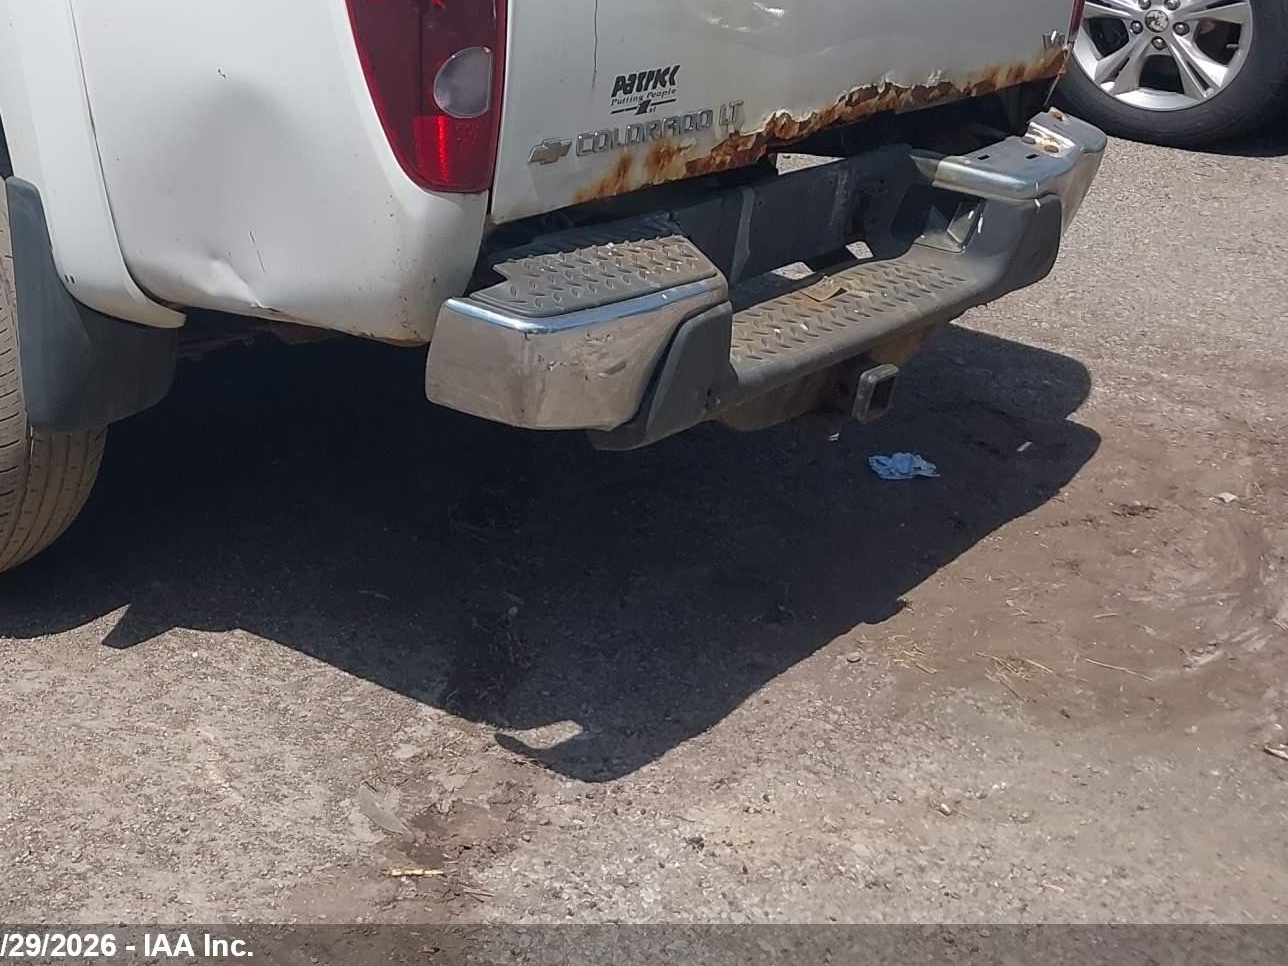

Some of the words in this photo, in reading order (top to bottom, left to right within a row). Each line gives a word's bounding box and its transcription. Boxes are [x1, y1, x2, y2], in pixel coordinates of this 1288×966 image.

[611, 94, 644, 107] Putting
[576, 109, 713, 156] COLORADO
[720, 101, 744, 128] LT
